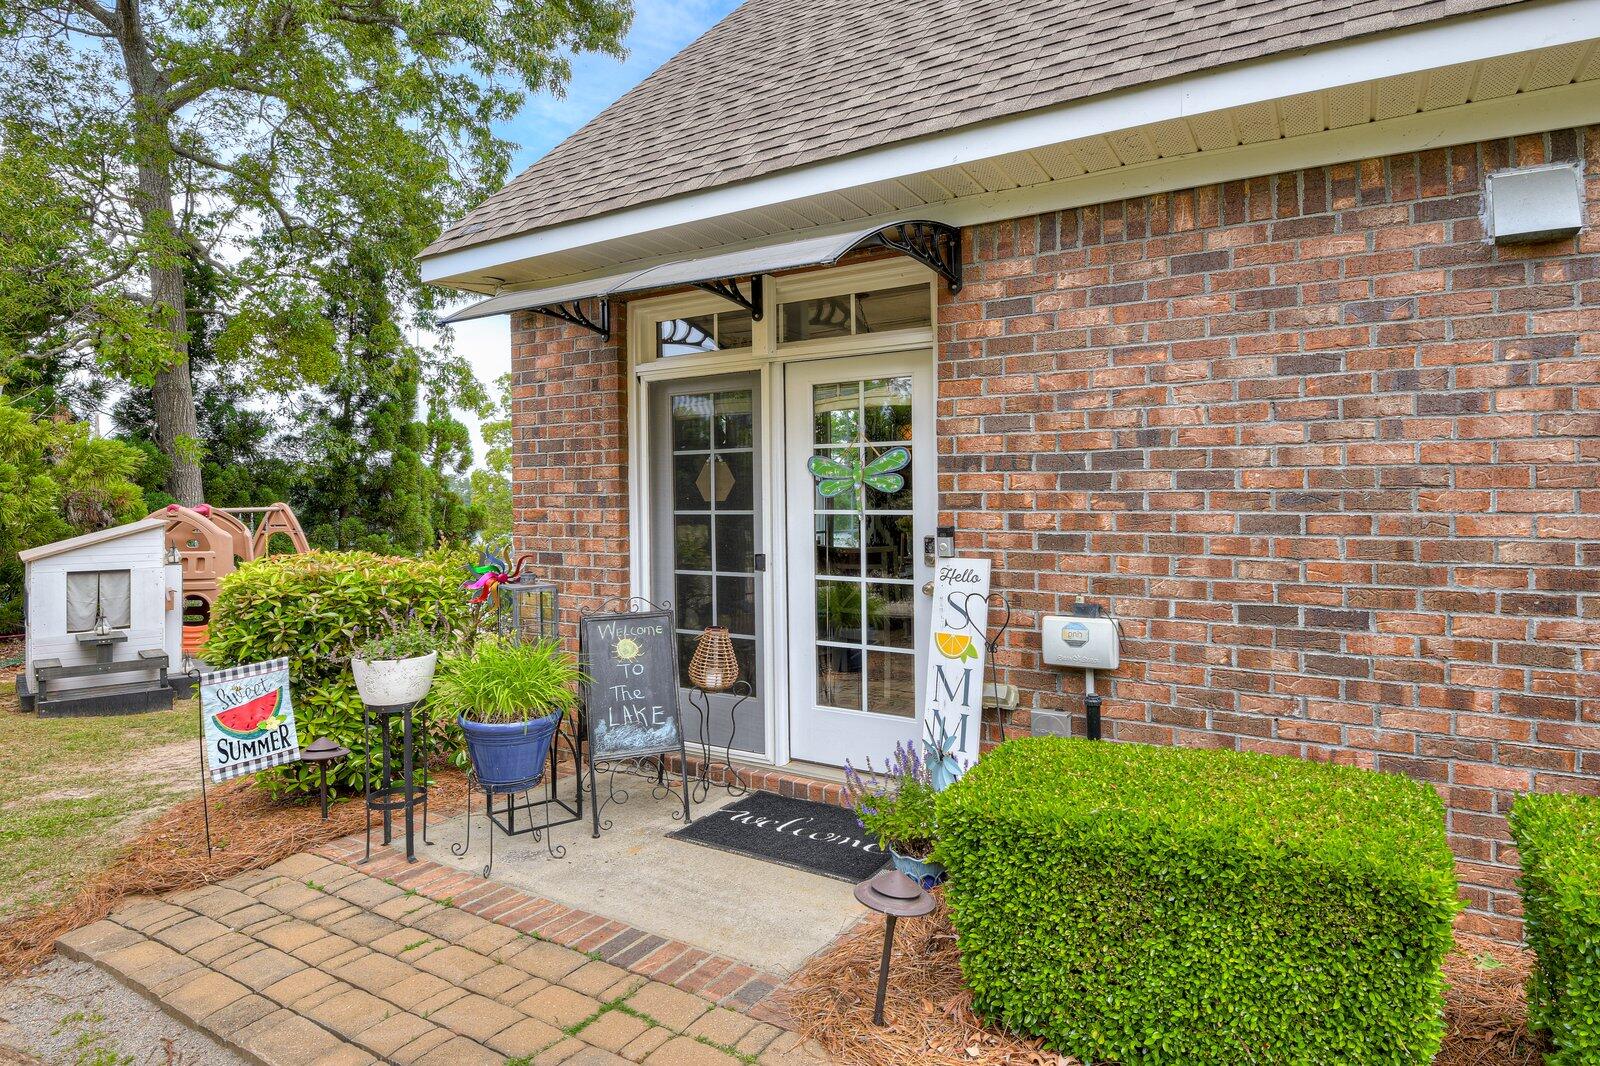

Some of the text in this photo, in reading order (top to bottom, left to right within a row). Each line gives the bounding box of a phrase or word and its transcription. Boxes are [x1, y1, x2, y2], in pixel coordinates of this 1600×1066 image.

[939, 567, 982, 586] Hello
[616, 663, 644, 678] TO
[216, 678, 273, 710] Sweet
[609, 685, 645, 701] The
[608, 704, 665, 727] LAKE
[216, 724, 292, 764] SUMMER
